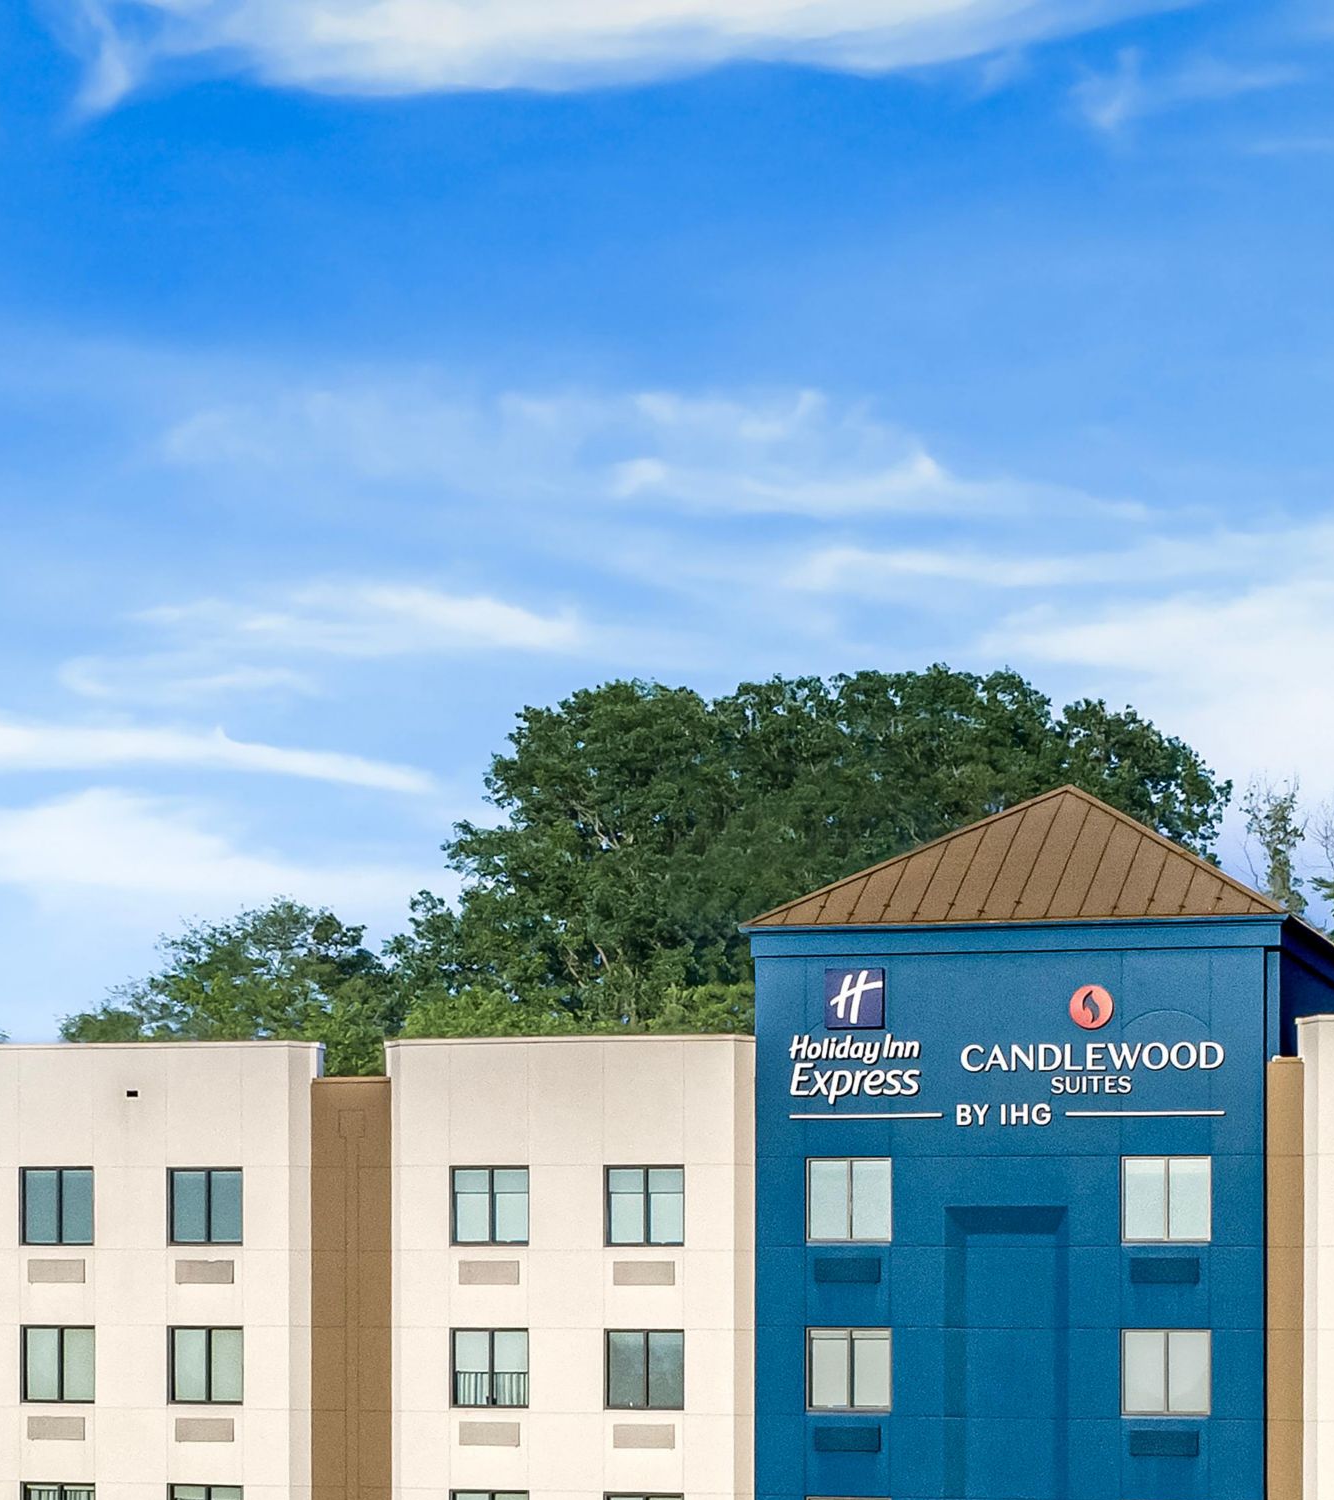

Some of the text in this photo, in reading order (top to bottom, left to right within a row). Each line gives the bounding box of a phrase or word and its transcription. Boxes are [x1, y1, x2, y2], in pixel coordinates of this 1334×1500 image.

[788, 1033, 920, 1064] Holiday Inn
[960, 1041, 1224, 1072] CANDLEWOOD
[789, 1062, 920, 1105] Express
[1050, 1075, 1132, 1094] SUITES
[956, 1103, 1052, 1126] BY IHG
